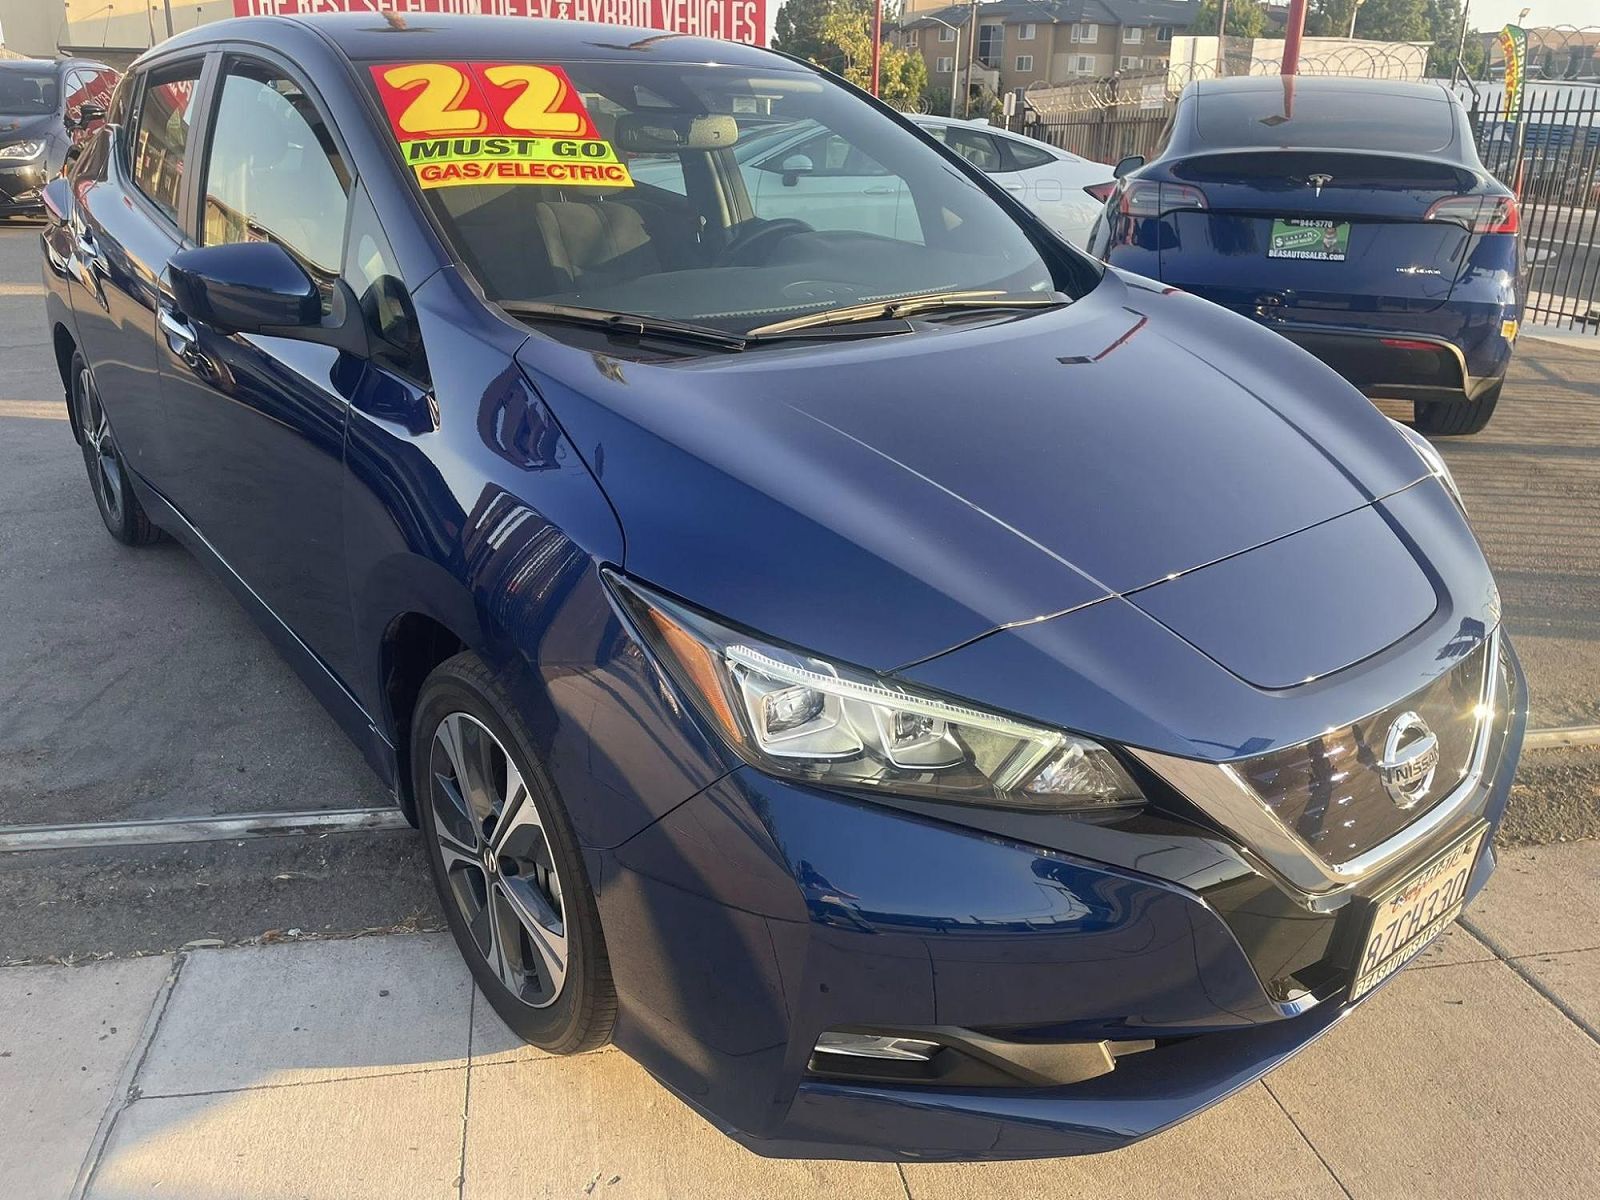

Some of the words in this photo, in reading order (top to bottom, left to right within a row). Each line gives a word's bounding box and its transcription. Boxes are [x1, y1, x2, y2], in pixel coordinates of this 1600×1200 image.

[660, 0, 757, 45] VEHICLES
[409, 138, 537, 161] MUST
[551, 140, 608, 160] GO
[419, 161, 627, 182] GAS/ELECTRIC
[1396, 749, 1439, 782] NISSAN
